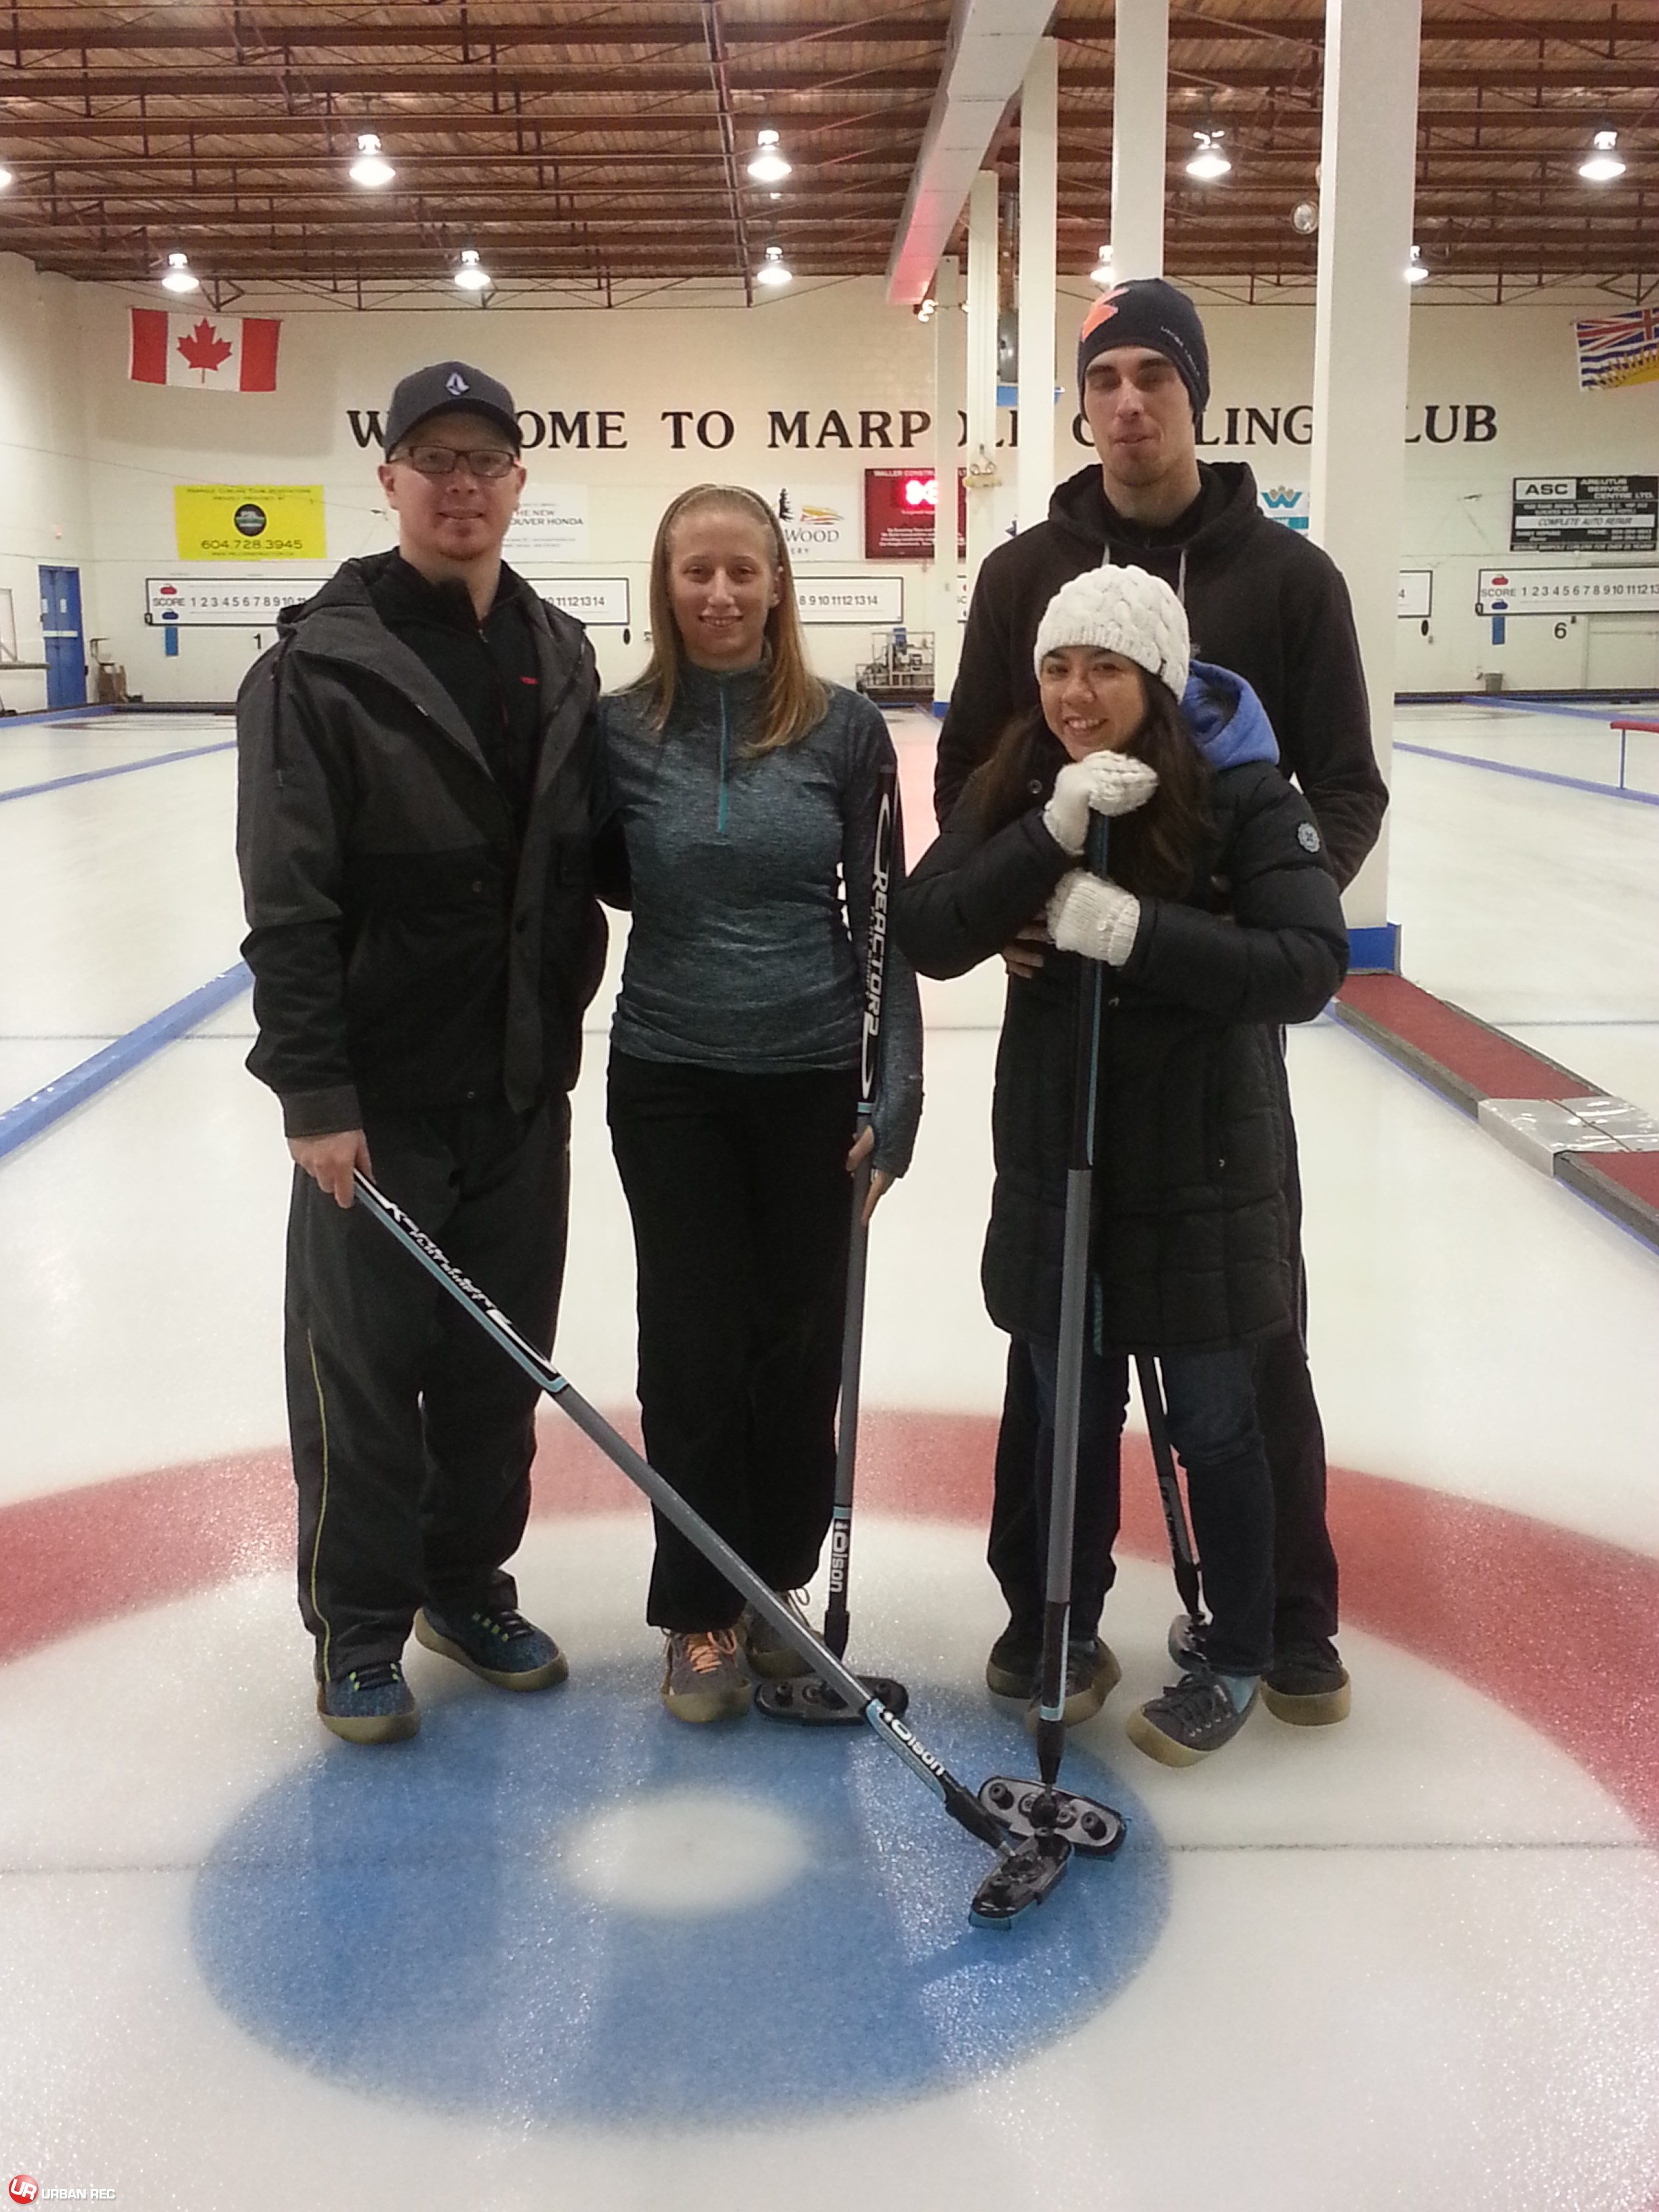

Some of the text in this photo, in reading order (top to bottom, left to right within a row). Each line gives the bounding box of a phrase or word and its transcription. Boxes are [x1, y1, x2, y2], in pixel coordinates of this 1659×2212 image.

[346, 409, 628, 449] WOME
[661, 409, 735, 449] TO
[1525, 483, 1568, 495] ASC
[547, 517, 584, 525] HONDA
[1538, 517, 1633, 527] COMPLETE AUTO REPAIR
[1481, 588, 1516, 598] SCORE
[1522, 587, 1528, 596] 1
[1532, 586, 1540, 596] 2
[1541, 586, 1549, 596] 3
[1552, 586, 1560, 596] 4
[1563, 586, 1570, 596] 5
[1572, 586, 1580, 596] 6
[1583, 586, 1590, 596] 7
[1593, 585, 1600, 595] 8
[1603, 585, 1611, 595] 9
[1612, 584, 1624, 595] 10
[1626, 584, 1636, 595] 11
[1637, 583, 1648, 594] 12
[152, 597, 185, 607] SCORE
[190, 597, 196, 607] 1
[201, 597, 208, 607] 2
[211, 597, 218, 607] 3
[222, 597, 230, 607] 4
[232, 597, 239, 607] 5
[243, 596, 250, 607] 6
[253, 596, 261, 607] 7
[264, 596, 270, 607] 8
[273, 596, 281, 607] 9
[282, 596, 293, 606] 10
[567, 596, 577, 606] 12
[580, 596, 592, 606] 13
[593, 596, 605, 605] 14
[799, 596, 878, 605] 8 9 10 11 12 13 14
[1553, 621, 1568, 639] 6
[252, 633, 262, 649] 1
[830, 1531, 848, 1593] Olson
[890, 1718, 945, 1776] Olson
